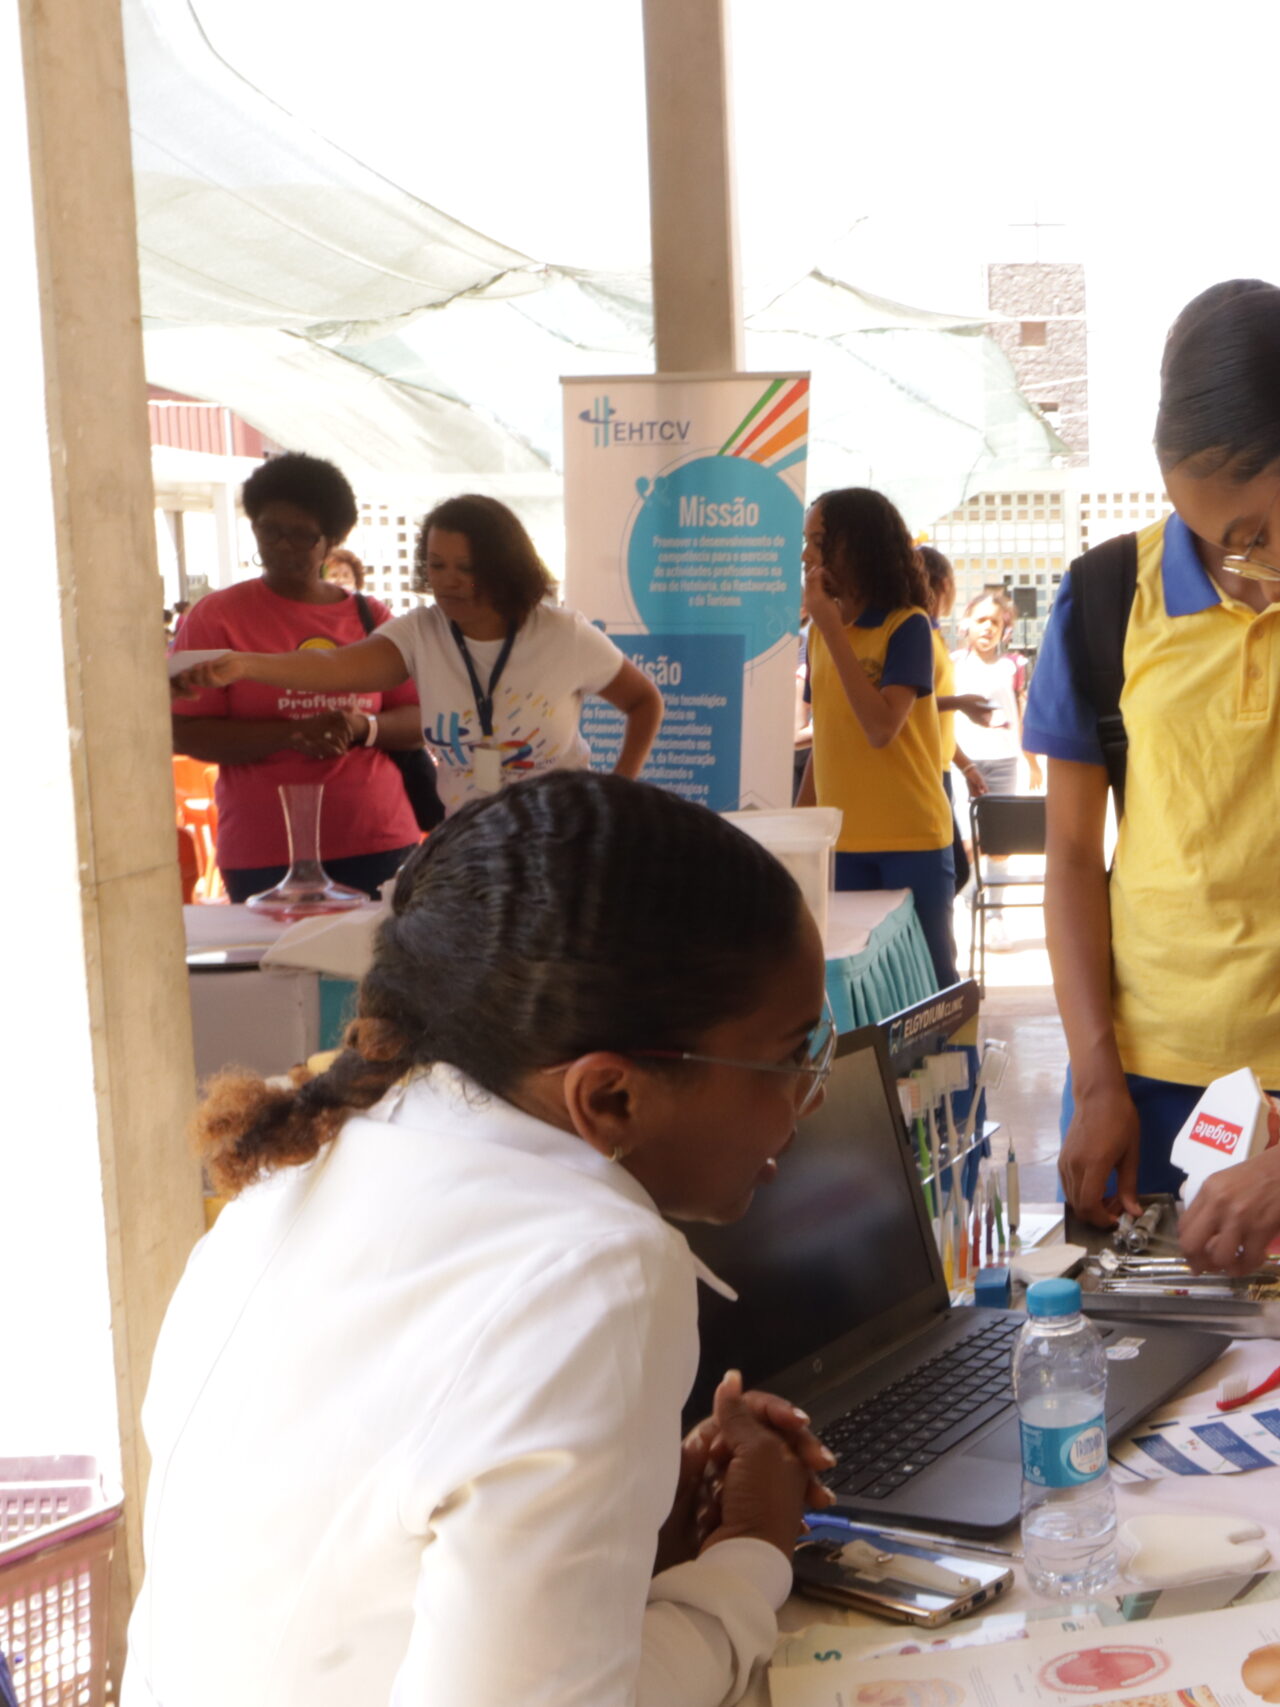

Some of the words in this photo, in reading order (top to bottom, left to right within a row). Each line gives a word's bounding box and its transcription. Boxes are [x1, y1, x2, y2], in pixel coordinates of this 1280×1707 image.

[614, 420, 691, 441] EHTCV
[679, 496, 759, 527] Missão
[652, 536, 692, 547] Promover
[699, 536, 772, 547] desenvolvimento
[657, 550, 711, 564] competência
[712, 552, 732, 564] para
[713, 565, 769, 578] profissionais
[733, 581, 787, 594] Restauração
[681, 693, 727, 708] tecnológico
[667, 752, 716, 767] Restauração
[904, 1000, 946, 1039] ELGYDIUM
[1195, 1120, 1238, 1150] Colgate
